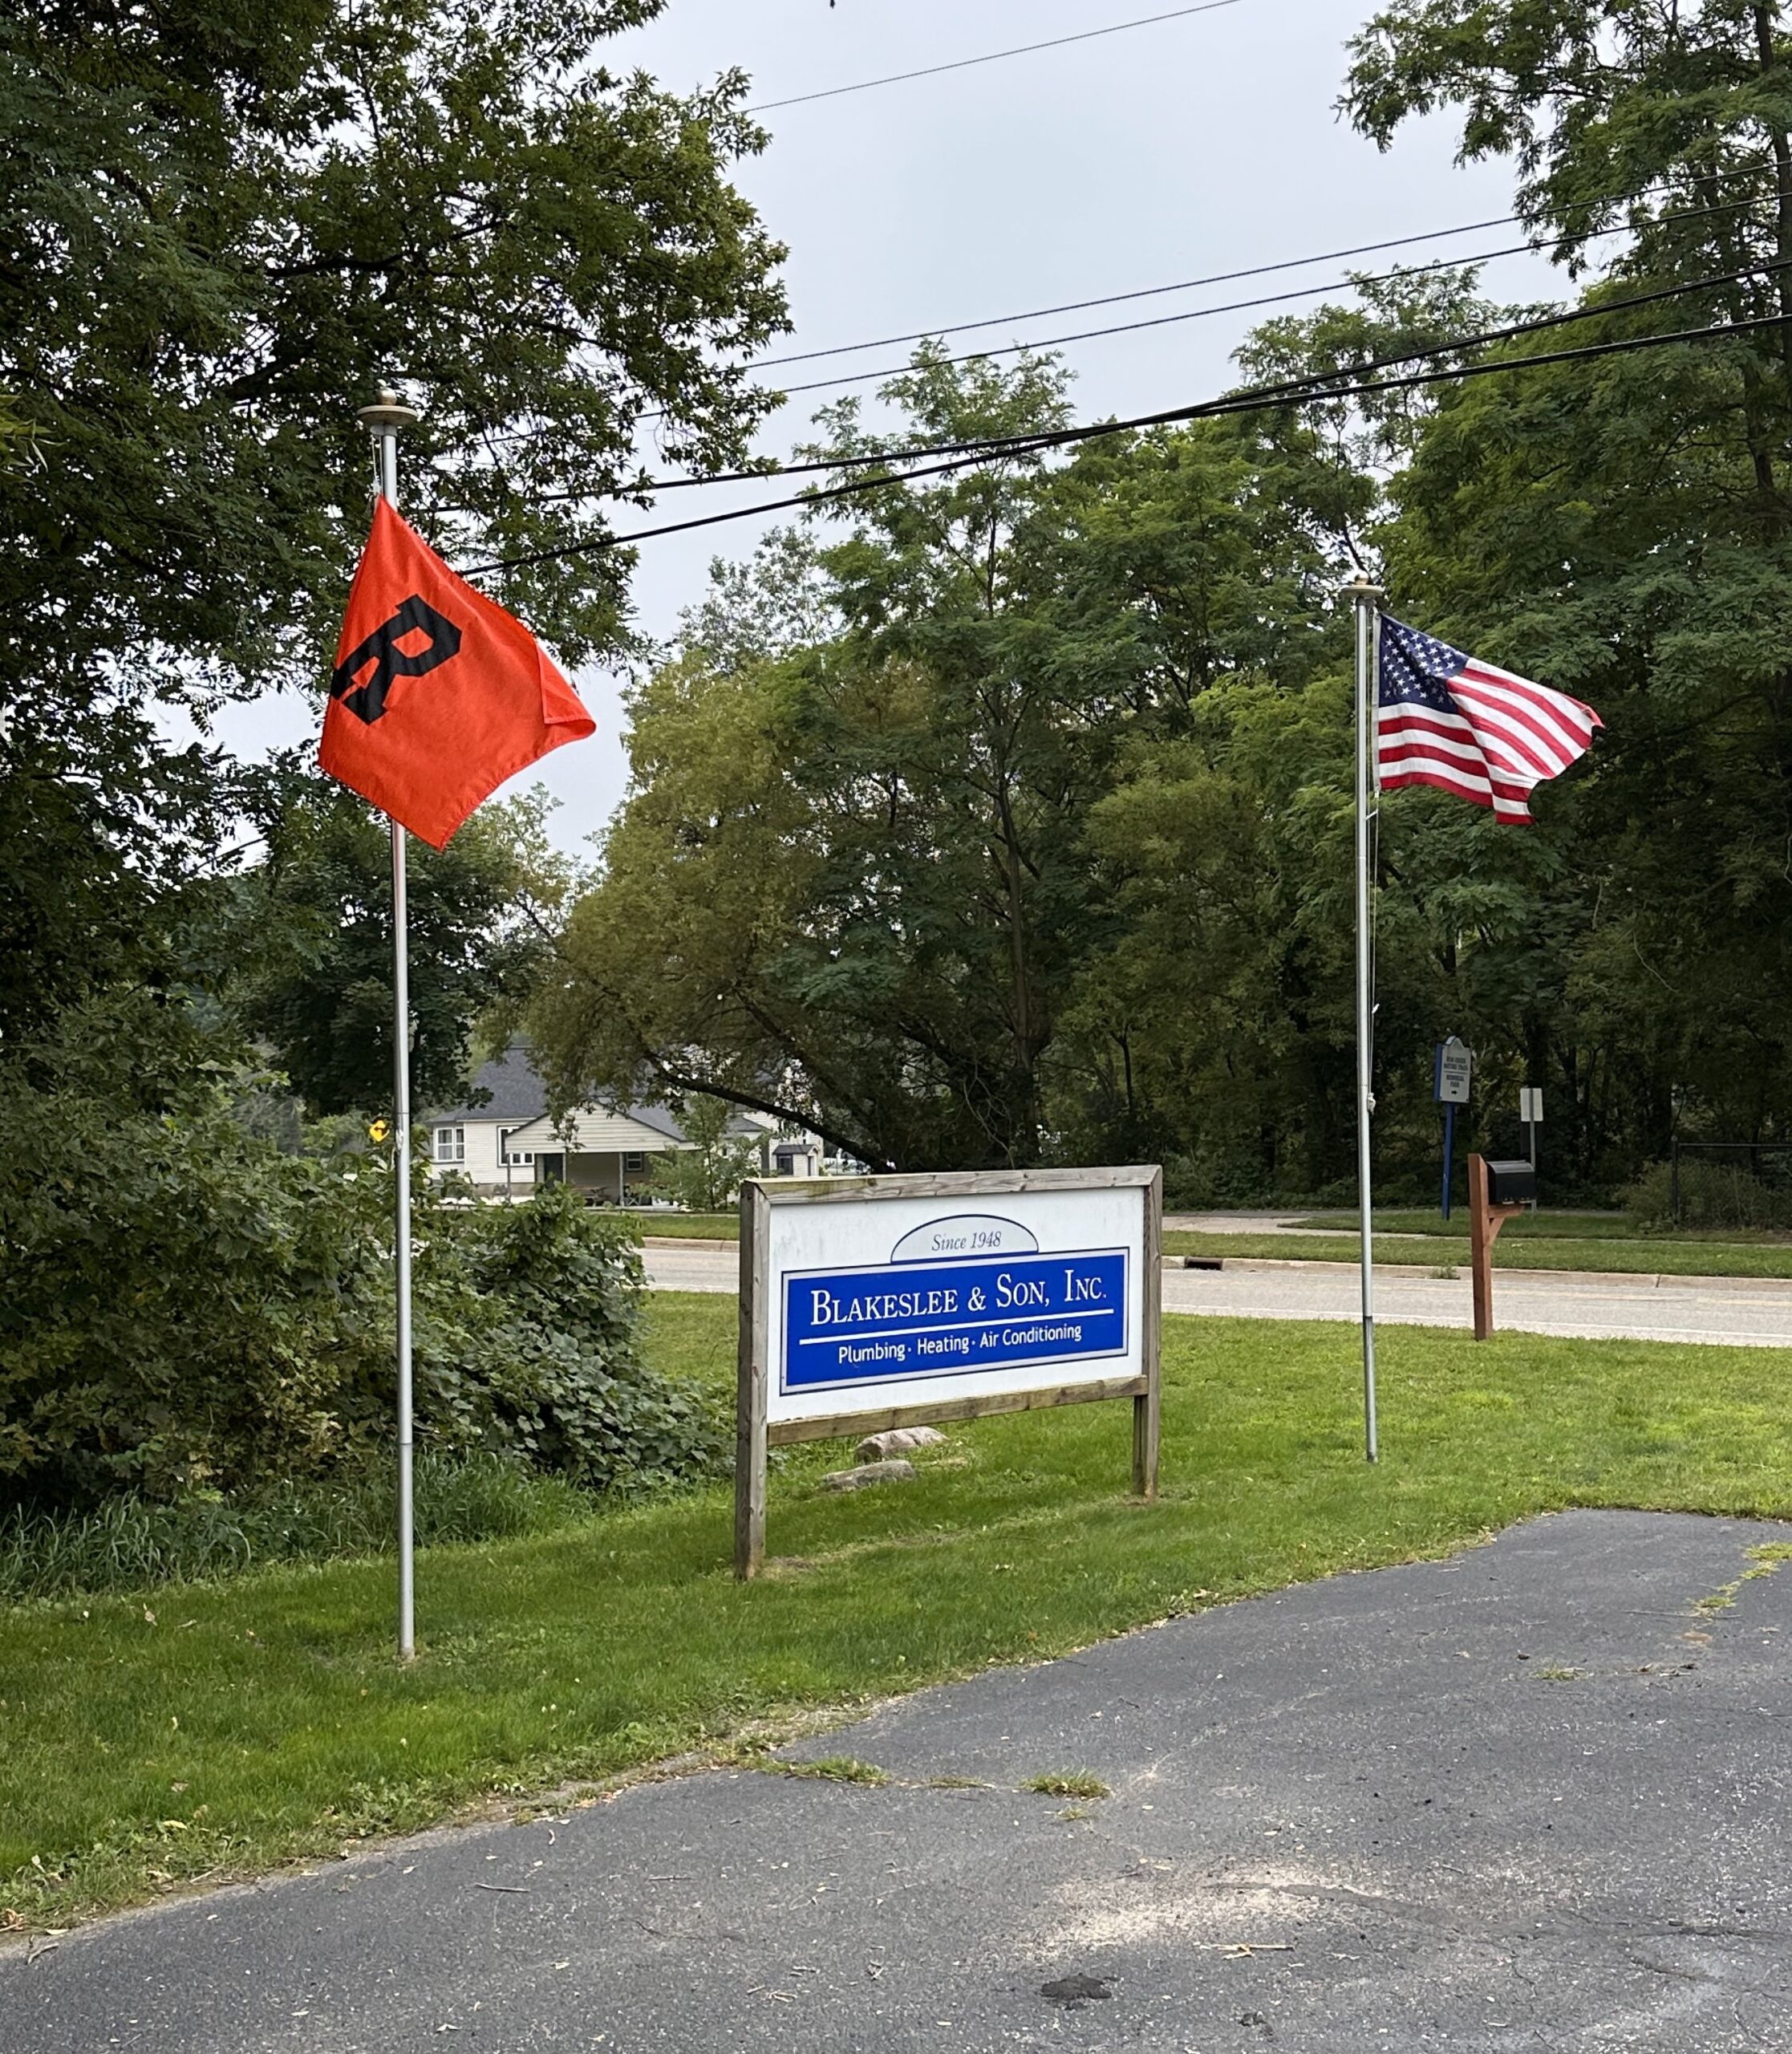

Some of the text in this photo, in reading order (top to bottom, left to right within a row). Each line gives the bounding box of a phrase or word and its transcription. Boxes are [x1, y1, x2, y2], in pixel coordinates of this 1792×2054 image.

[330, 594, 462, 725] R
[931, 1231, 1002, 1252] Since 1948
[810, 1269, 1107, 1325] BLAKESLEE & SON, INC.
[979, 1330, 999, 1349] Air
[1002, 1323, 1082, 1346] Conditioning
